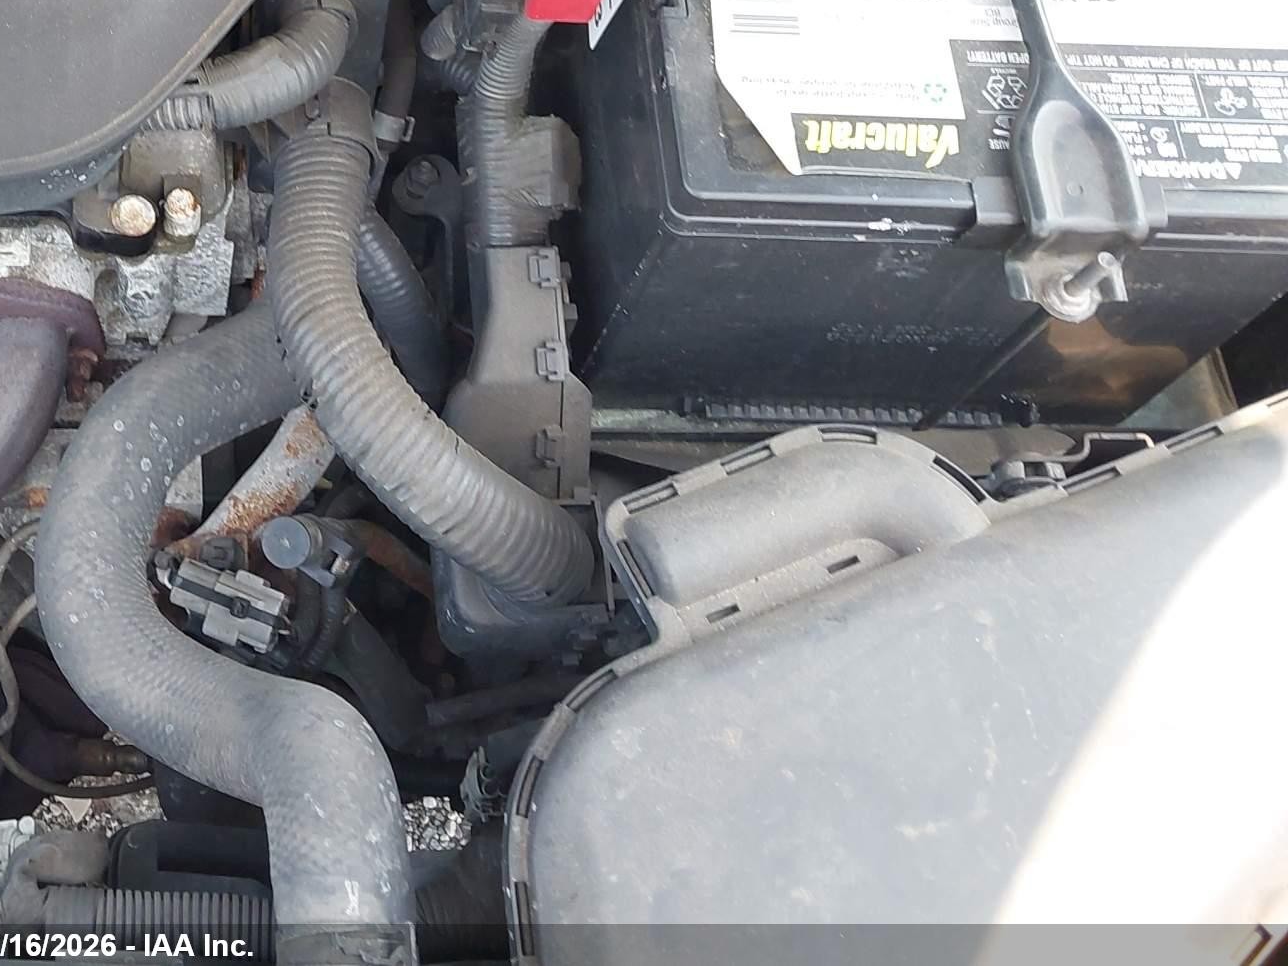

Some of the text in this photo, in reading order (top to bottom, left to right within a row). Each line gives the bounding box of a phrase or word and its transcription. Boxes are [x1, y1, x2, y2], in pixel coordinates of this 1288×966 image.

[1008, 51, 1030, 65] OPEN
[1085, 54, 1103, 67] NOT
[1102, 55, 1119, 67] DO
[802, 119, 960, 169] Valucraft
